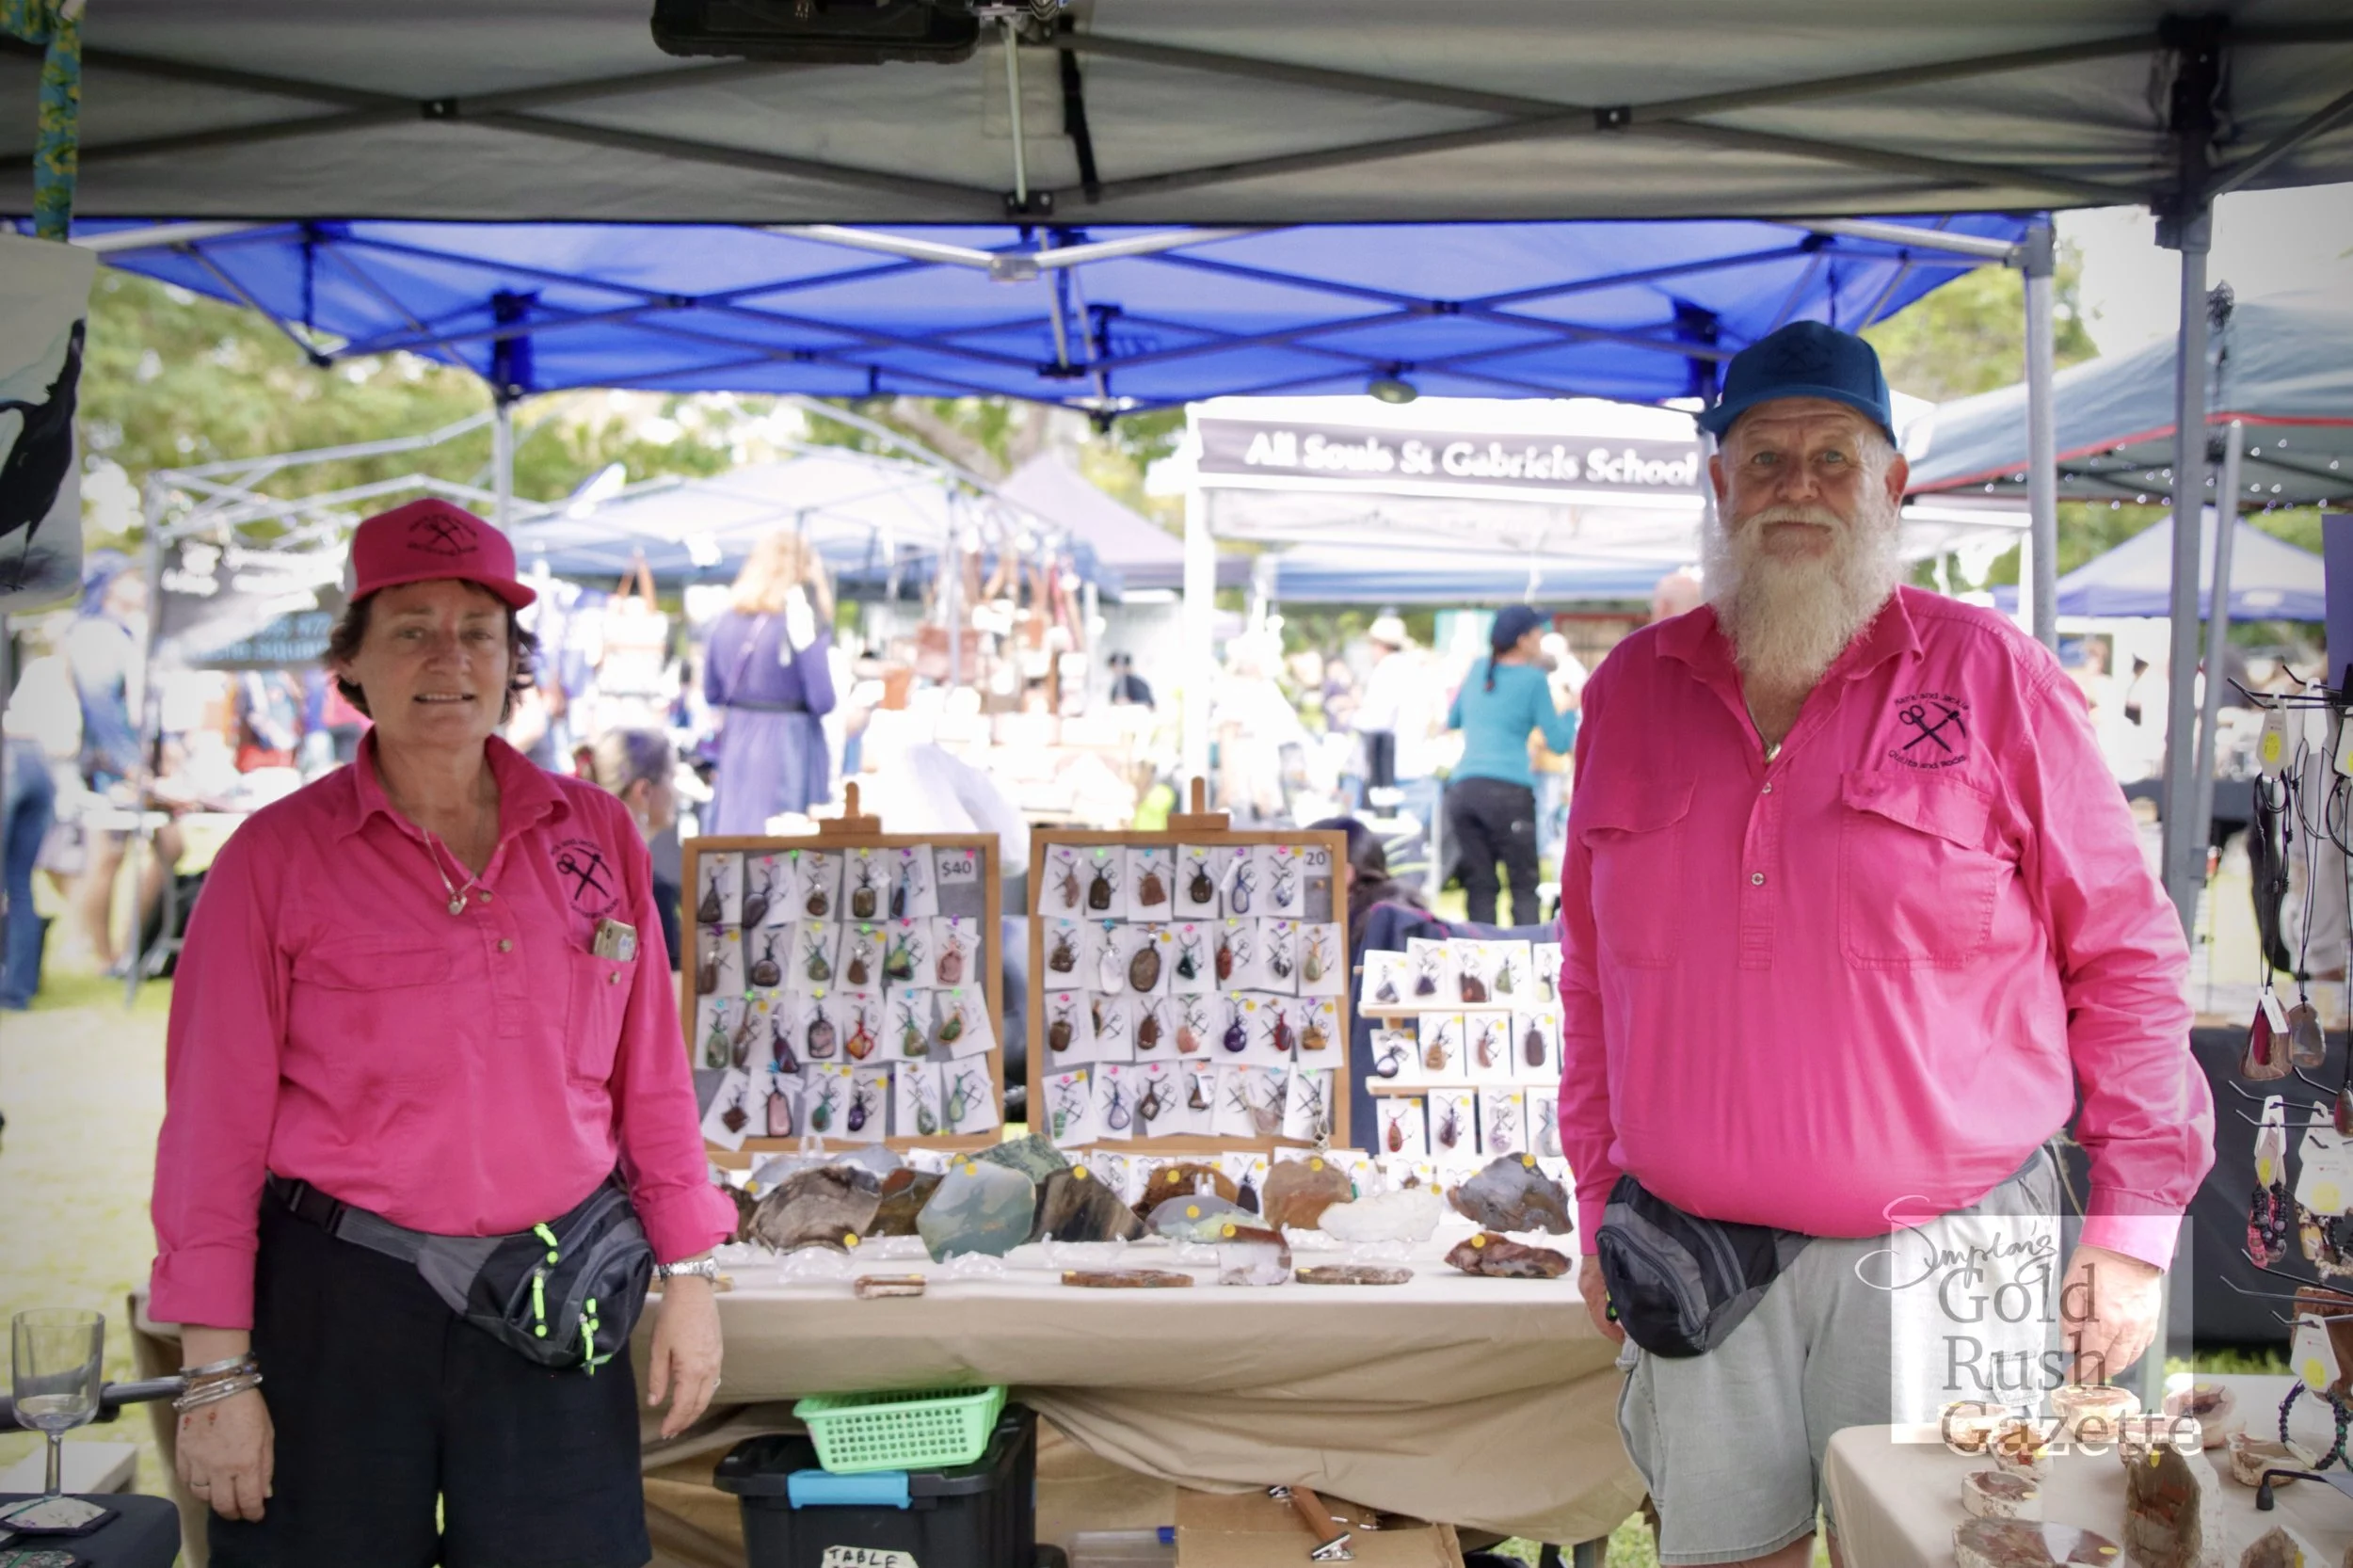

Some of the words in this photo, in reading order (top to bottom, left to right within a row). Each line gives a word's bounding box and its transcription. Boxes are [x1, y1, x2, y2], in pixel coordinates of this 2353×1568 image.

[1245, 431, 1297, 467] All
[1304, 434, 1395, 472] Souls
[1400, 440, 1434, 475] St
[1441, 441, 1579, 482] Gabriels
[1585, 447, 1700, 487] School
[941, 859, 971, 877] $40
[829, 1548, 899, 1568] TABLE
